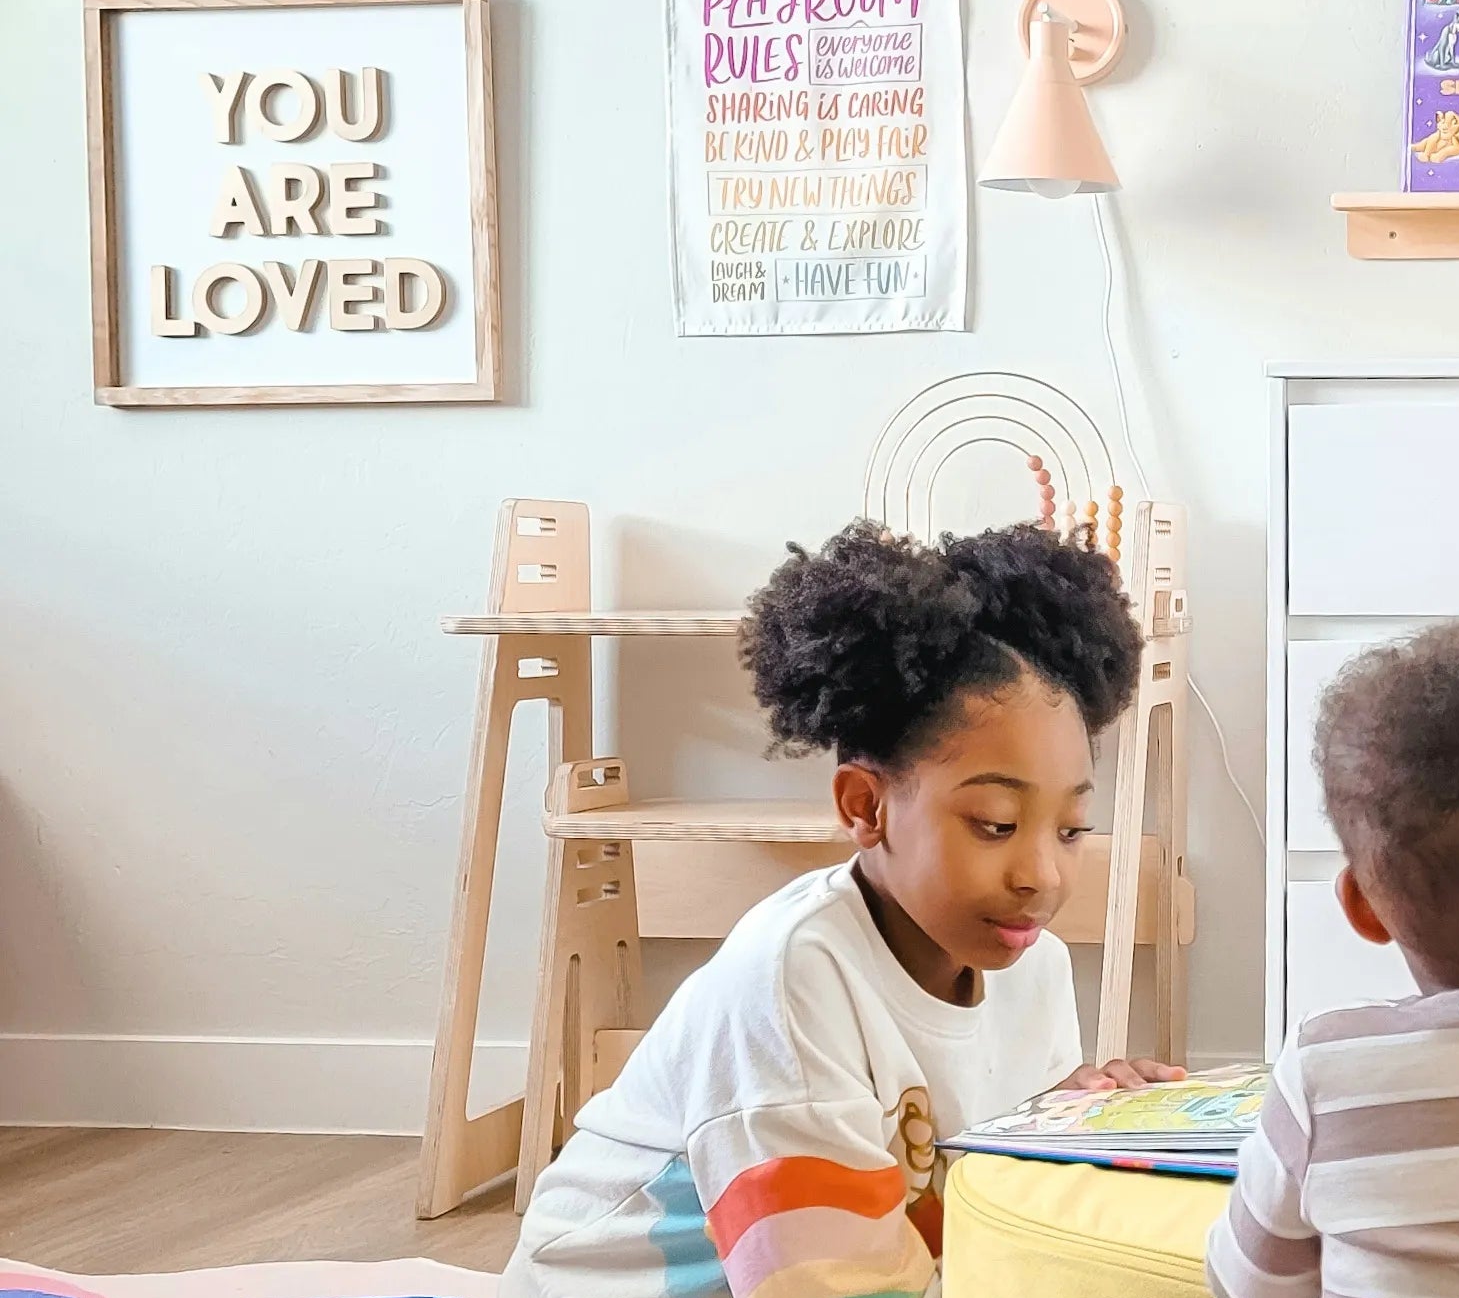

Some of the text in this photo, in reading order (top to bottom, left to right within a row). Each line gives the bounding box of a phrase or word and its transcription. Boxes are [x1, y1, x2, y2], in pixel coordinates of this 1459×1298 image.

[704, 32, 803, 88] RULES
[815, 31, 913, 57] everyone
[815, 60, 834, 78] is
[199, 66, 386, 144] YOU
[795, 129, 814, 162] &
[821, 127, 871, 162] PLAY
[209, 162, 379, 236] ARE
[715, 175, 763, 210] TRY
[711, 217, 925, 255] CREATE & EXPLORE
[711, 260, 766, 282] LAUGH &
[795, 261, 910, 298] HAVE FUN
[151, 256, 447, 338] LOVED
[712, 281, 765, 303] DREAM
